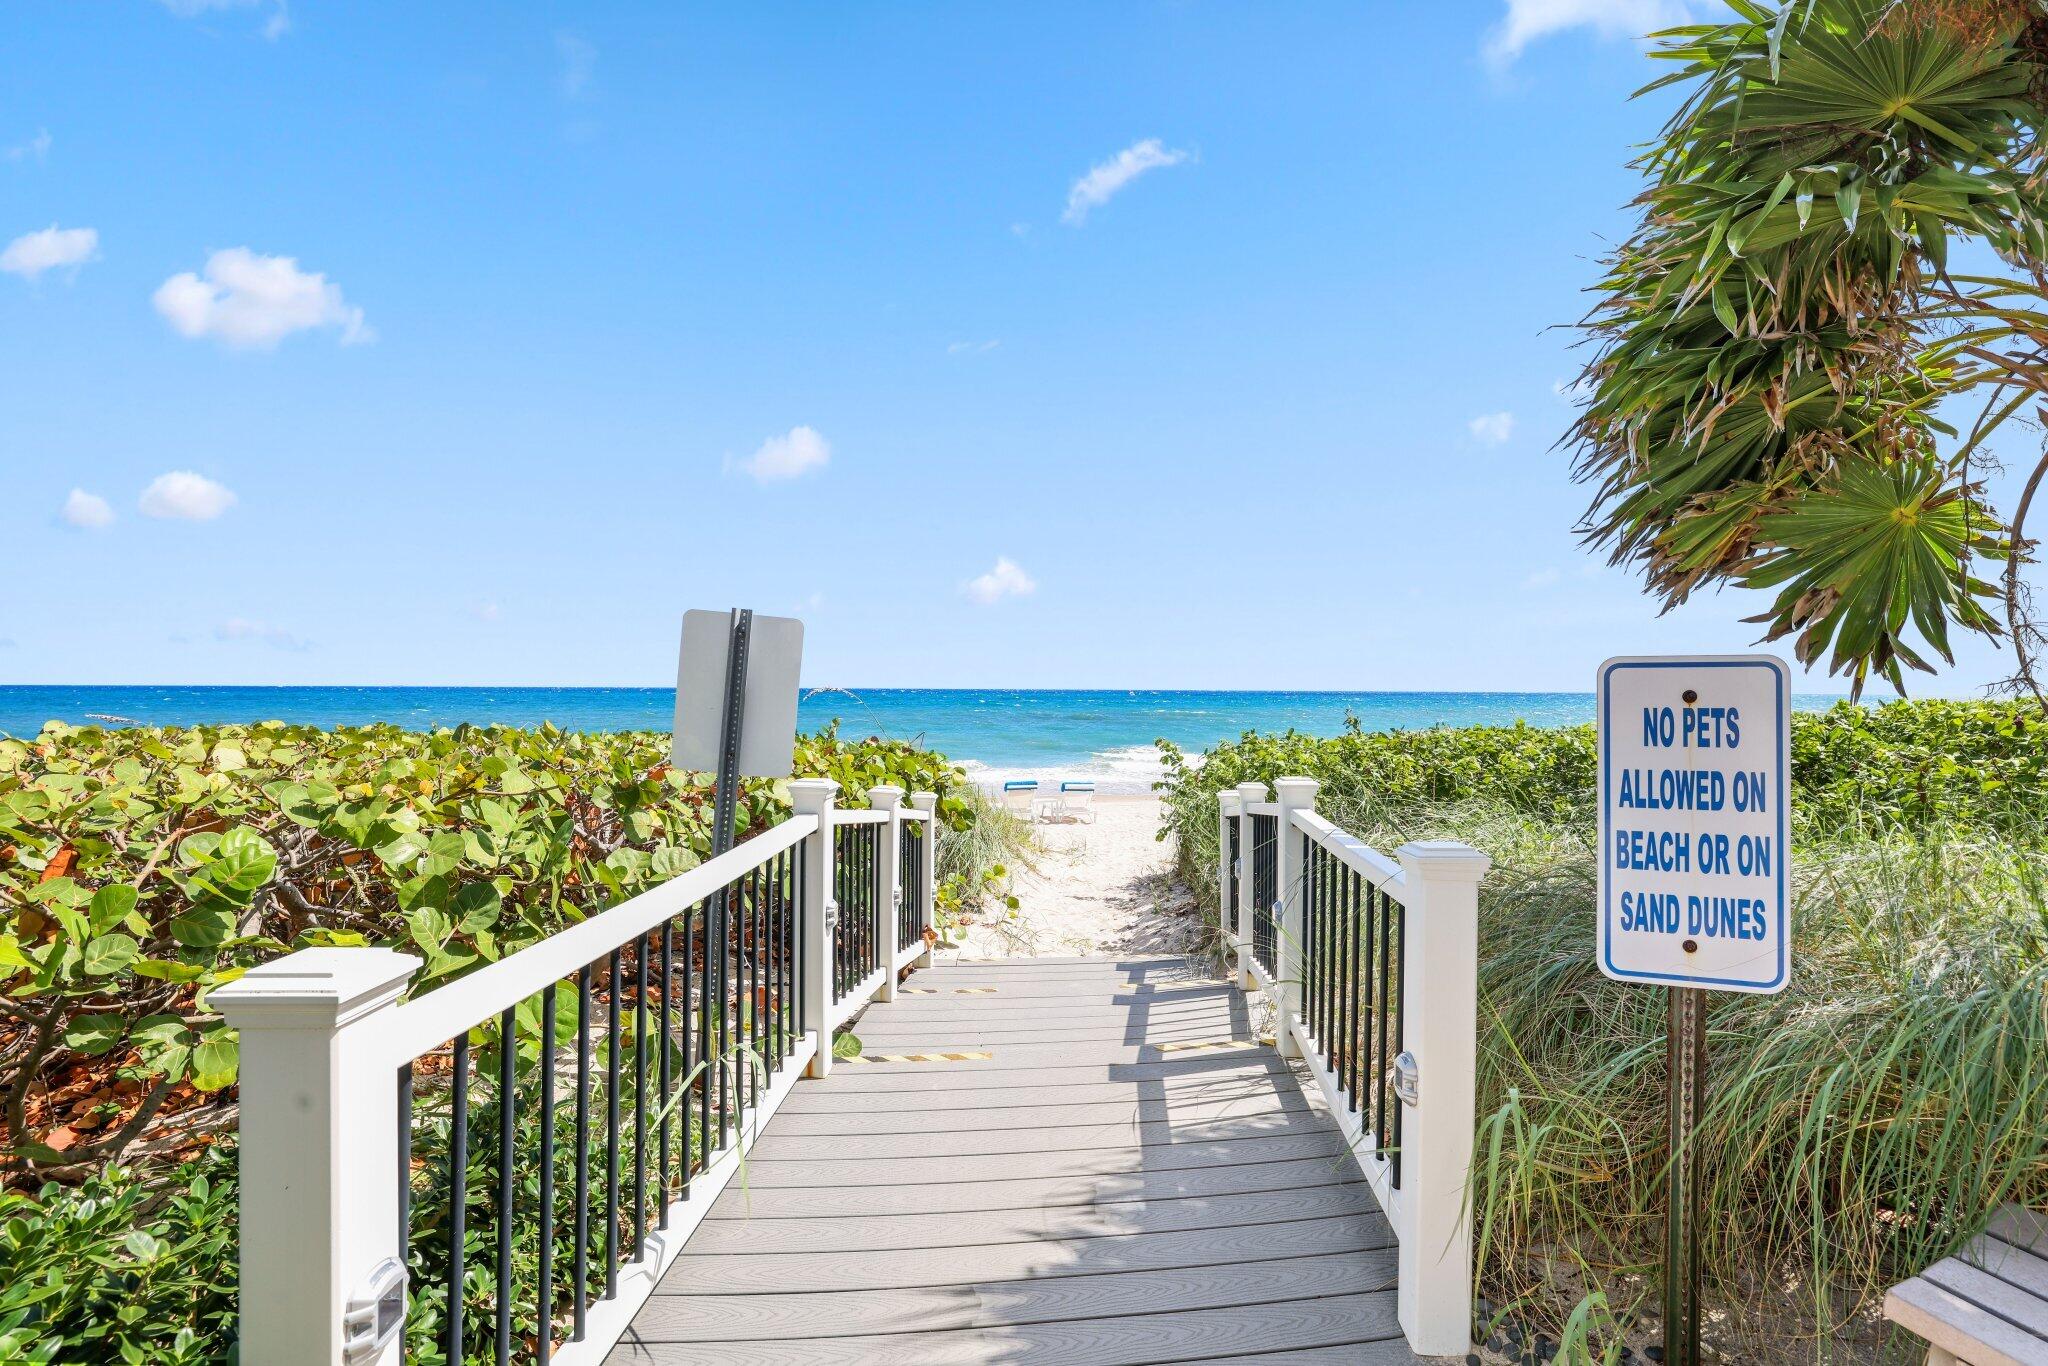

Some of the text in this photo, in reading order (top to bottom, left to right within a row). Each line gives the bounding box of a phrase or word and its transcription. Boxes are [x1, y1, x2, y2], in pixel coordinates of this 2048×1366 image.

[1643, 707, 1740, 749] NO PETS
[1619, 769, 1767, 813] ALLOWED ON
[1616, 830, 1771, 877] BEACH OR ON
[1620, 891, 1767, 941] SAND DUNES
